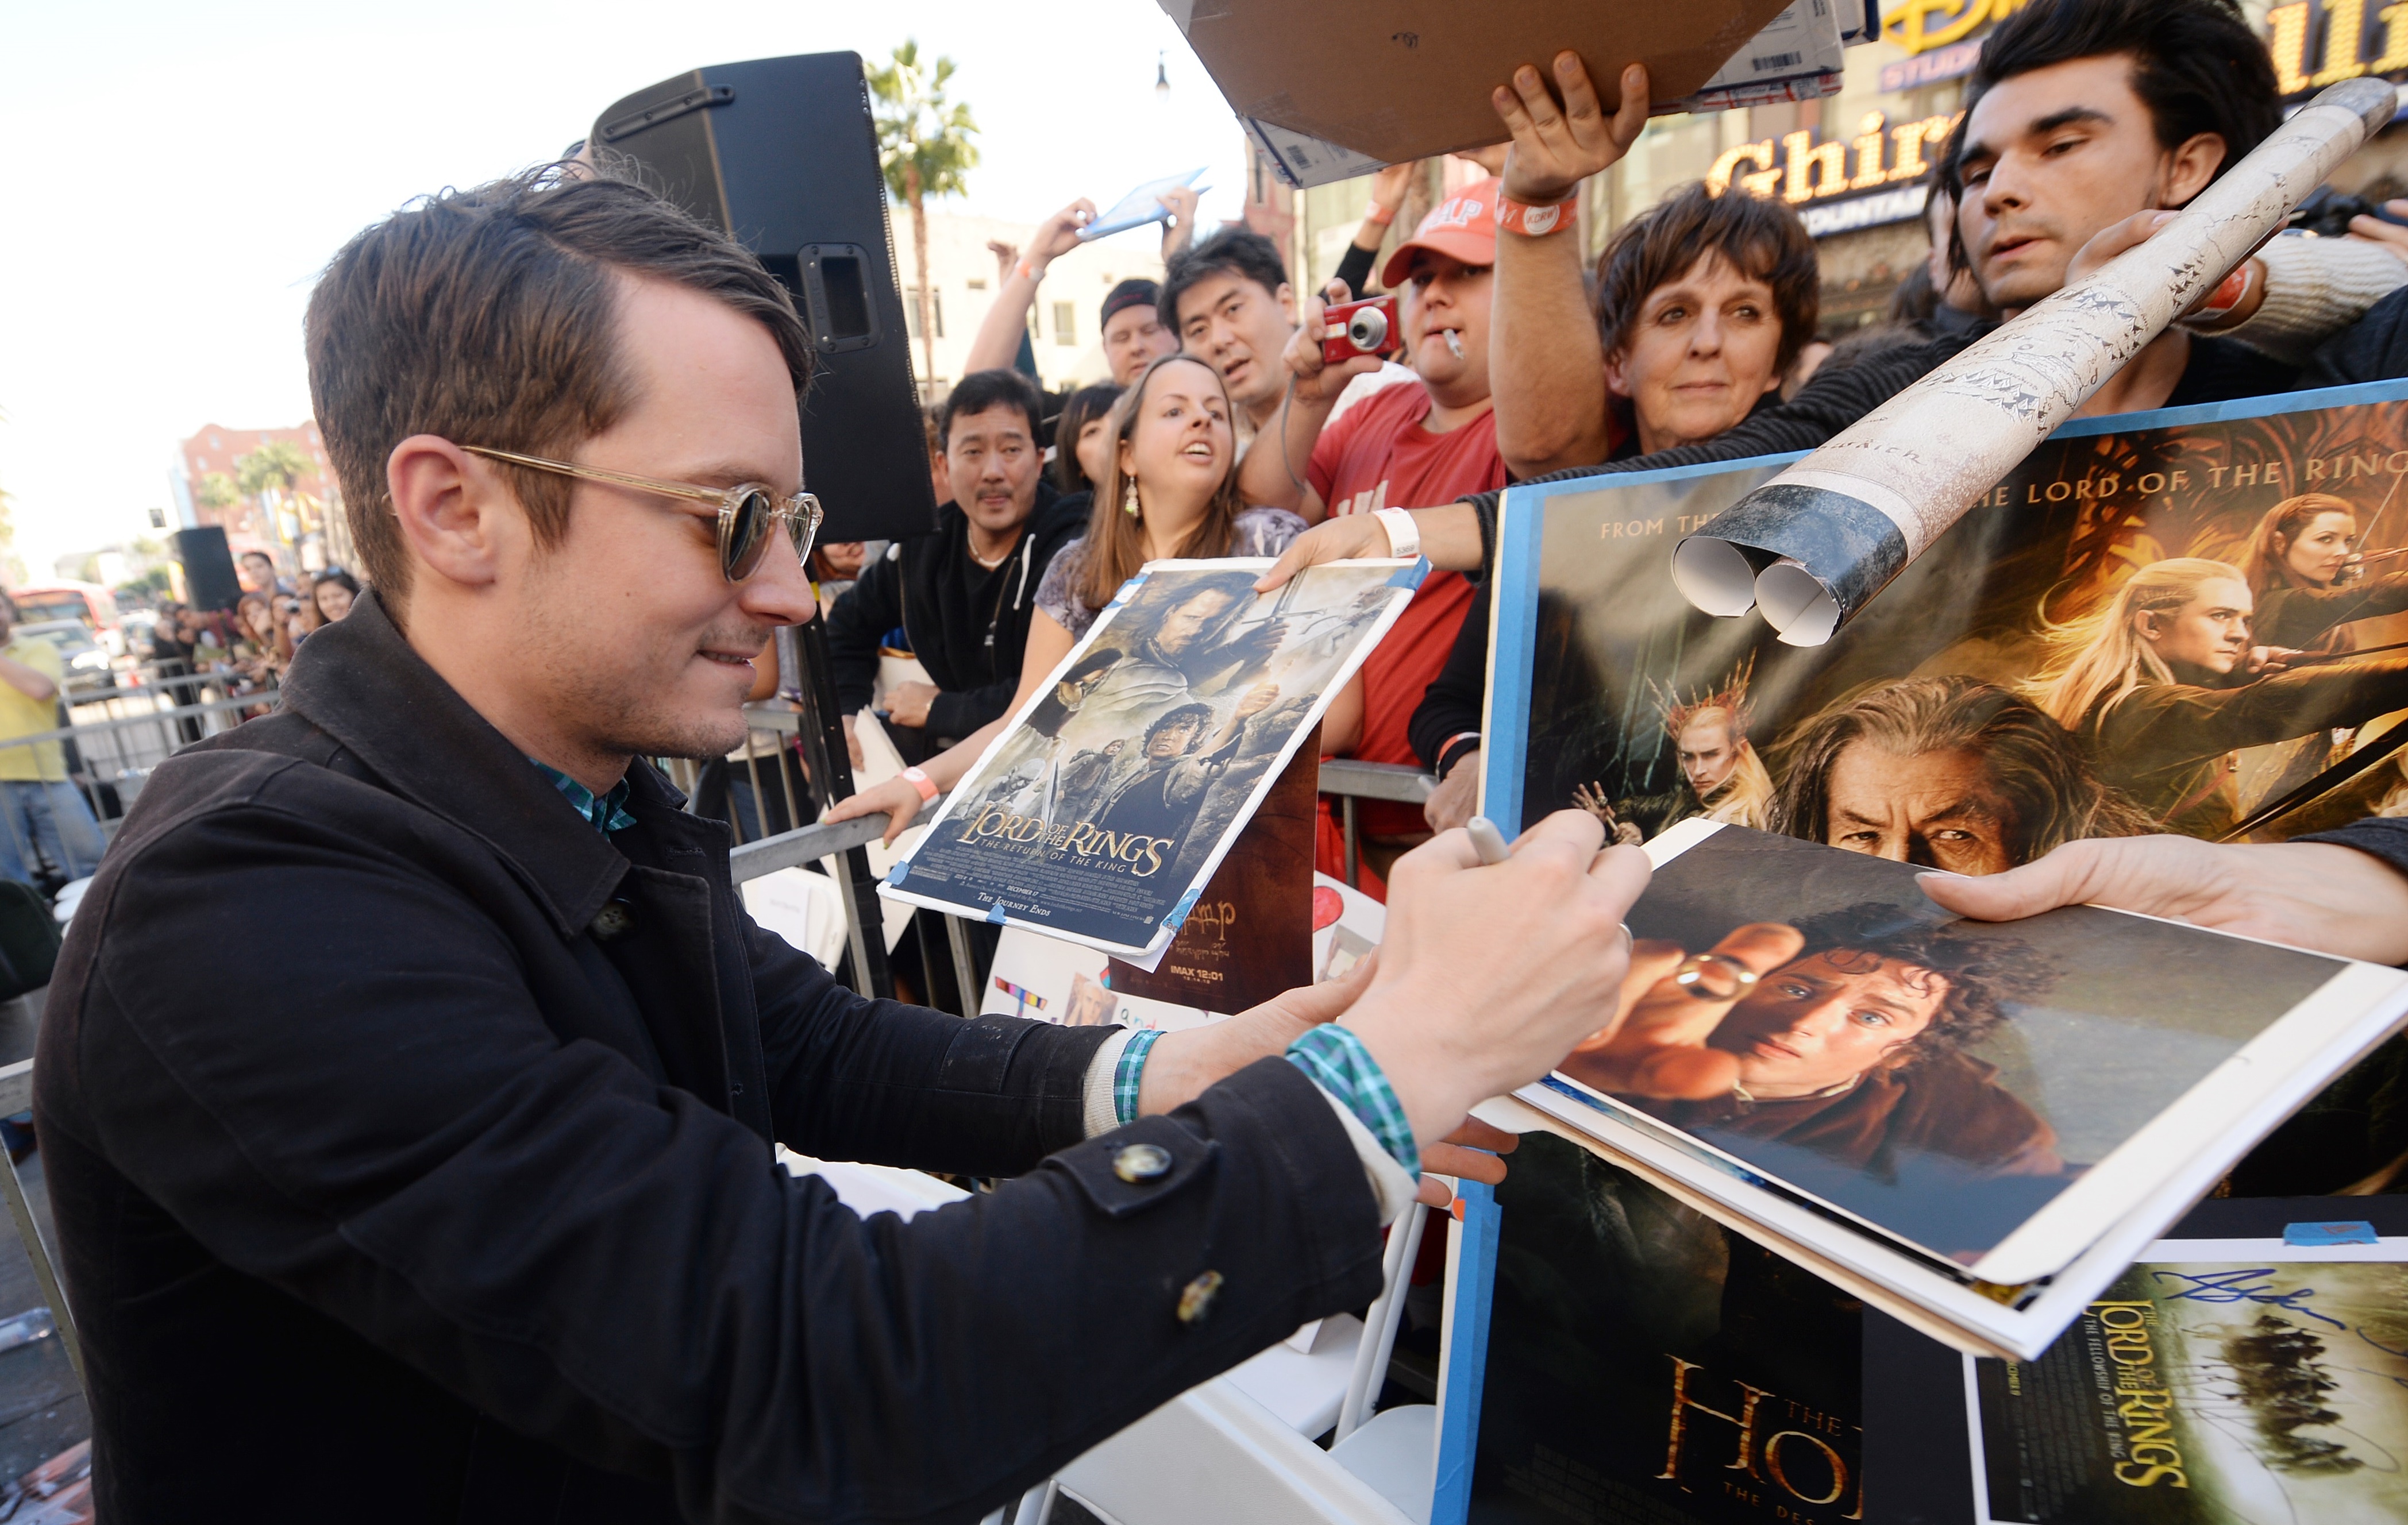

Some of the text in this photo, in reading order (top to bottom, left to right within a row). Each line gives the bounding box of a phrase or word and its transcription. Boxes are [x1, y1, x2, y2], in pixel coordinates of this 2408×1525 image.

[1706, 110, 1966, 203] Ghir
[1601, 518, 1663, 539] FROM
[1677, 512, 1720, 534] TH
[2028, 477, 2120, 505] LORD
[2136, 470, 2186, 495] OF
[2208, 461, 2283, 488] THE
[957, 802, 1045, 845] LORD
[1038, 831, 1066, 847] THE
[1047, 823, 1069, 836] OF
[980, 839, 999, 850] THE
[1003, 844, 1046, 858] RETURN
[1050, 852, 1065, 862] OF
[1071, 855, 1091, 867] THE
[1095, 860, 1127, 873] KING
[1056, 821, 1174, 878] RINGS
[977, 892, 1051, 916] THE JOURNEY ENDS
[1006, 885, 1032, 895] DECEMBER
[1171, 966, 1224, 982] IMAX 12:01
[1121, 1009, 1157, 1030] and
[2082, 1299, 2155, 1366] LORD
[2084, 1320, 2126, 1458] THE FELLOWSHIP OF THE RING
[2116, 1365, 2140, 1389] THE
[1784, 1399, 1842, 1437] THE
[1654, 1353, 1862, 1520] HO
[2113, 1386, 2189, 1489] RINGS
[1724, 1481, 1760, 1507] THE
